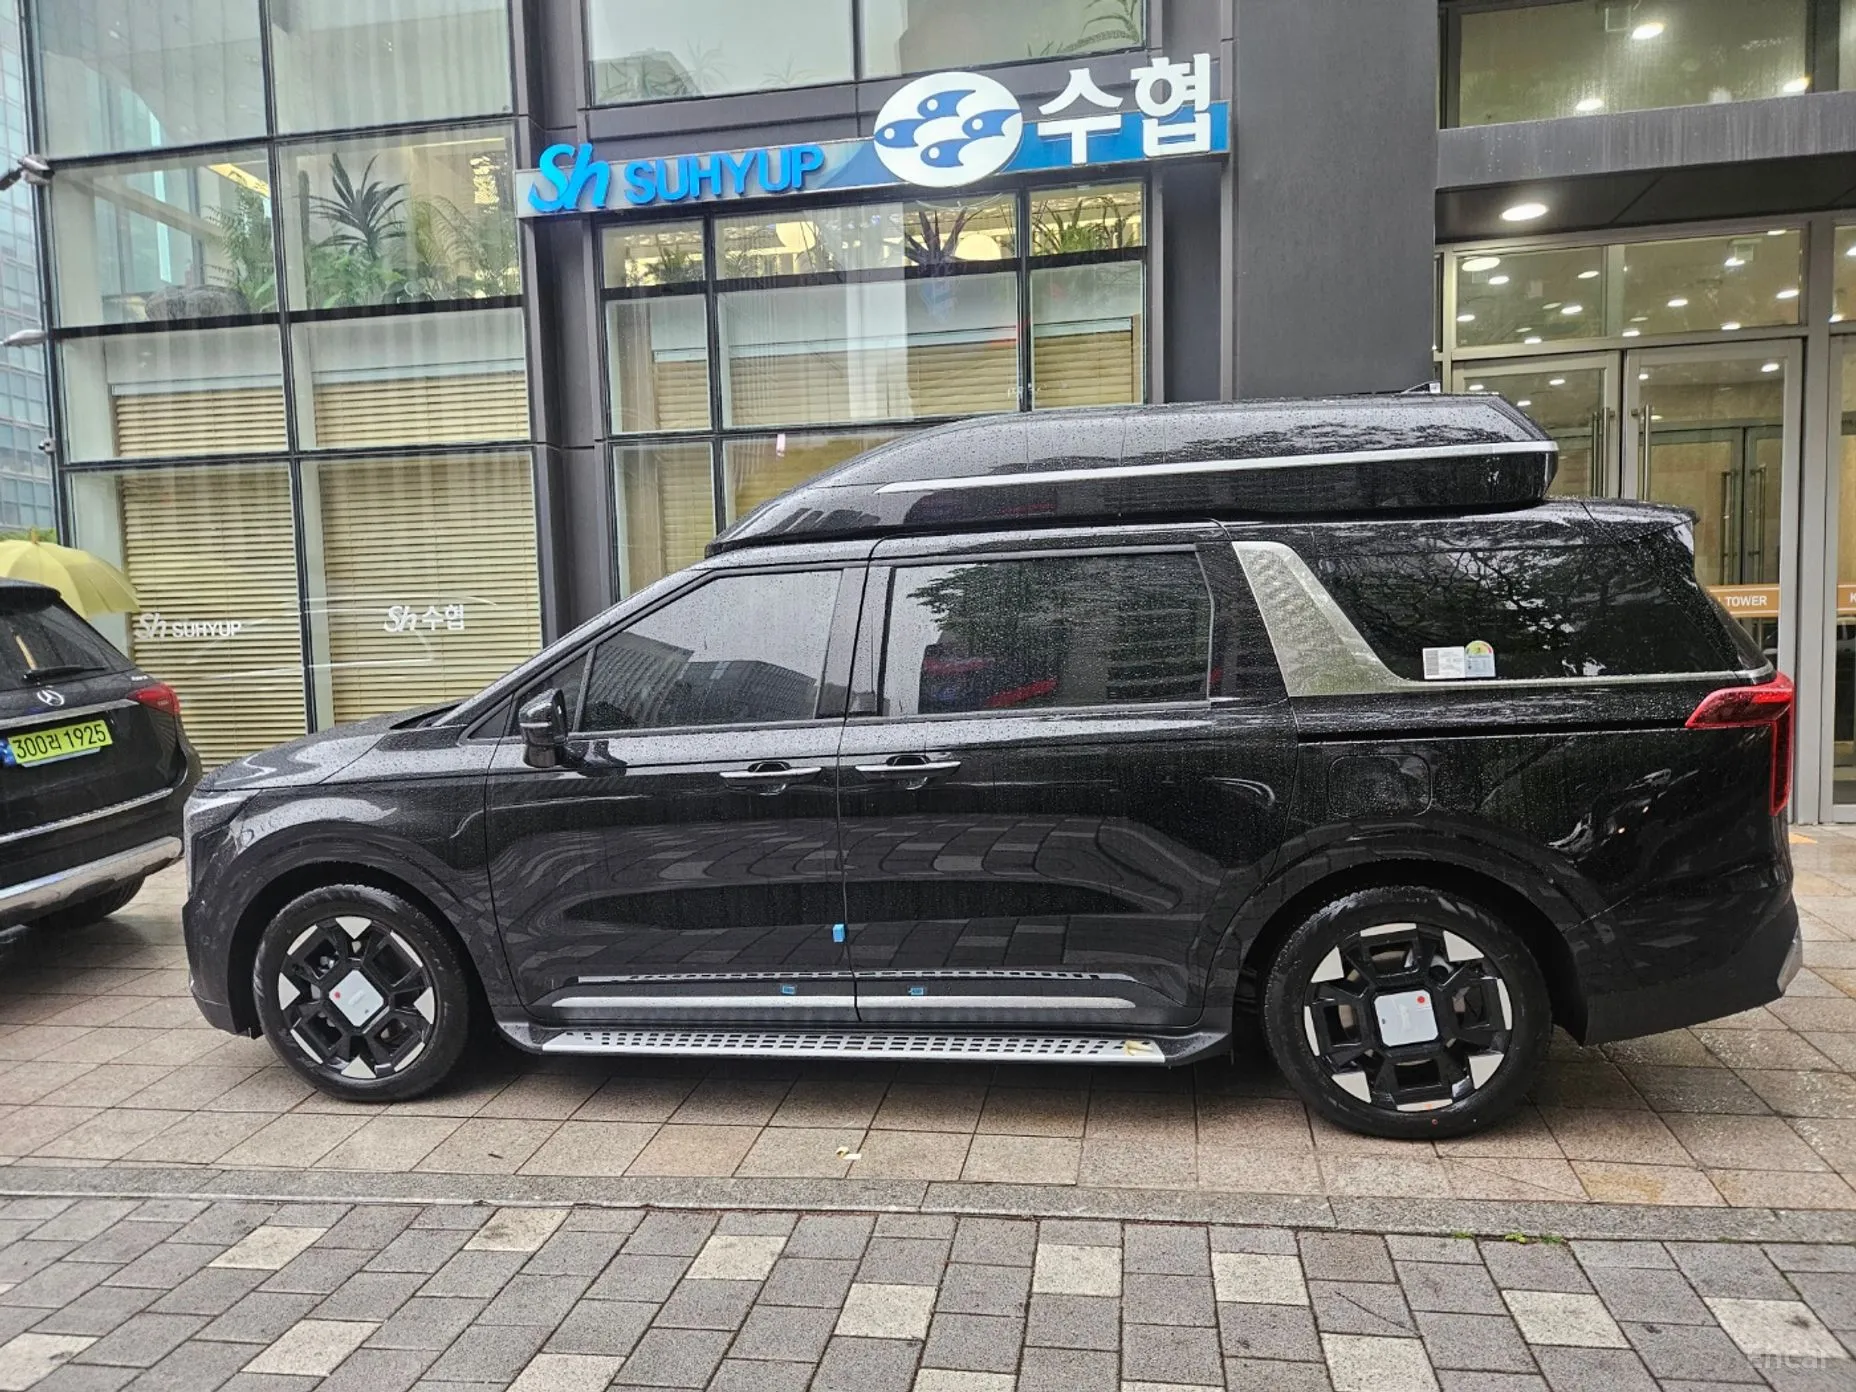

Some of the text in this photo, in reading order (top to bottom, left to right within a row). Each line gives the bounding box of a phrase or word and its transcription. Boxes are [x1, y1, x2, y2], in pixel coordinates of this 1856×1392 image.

[528, 53, 1211, 213] Sh SUHYUP 수협
[1726, 596, 1767, 607] TOWER
[134, 613, 241, 639] Sh SUHYUP
[64, 724, 106, 748] 1925
